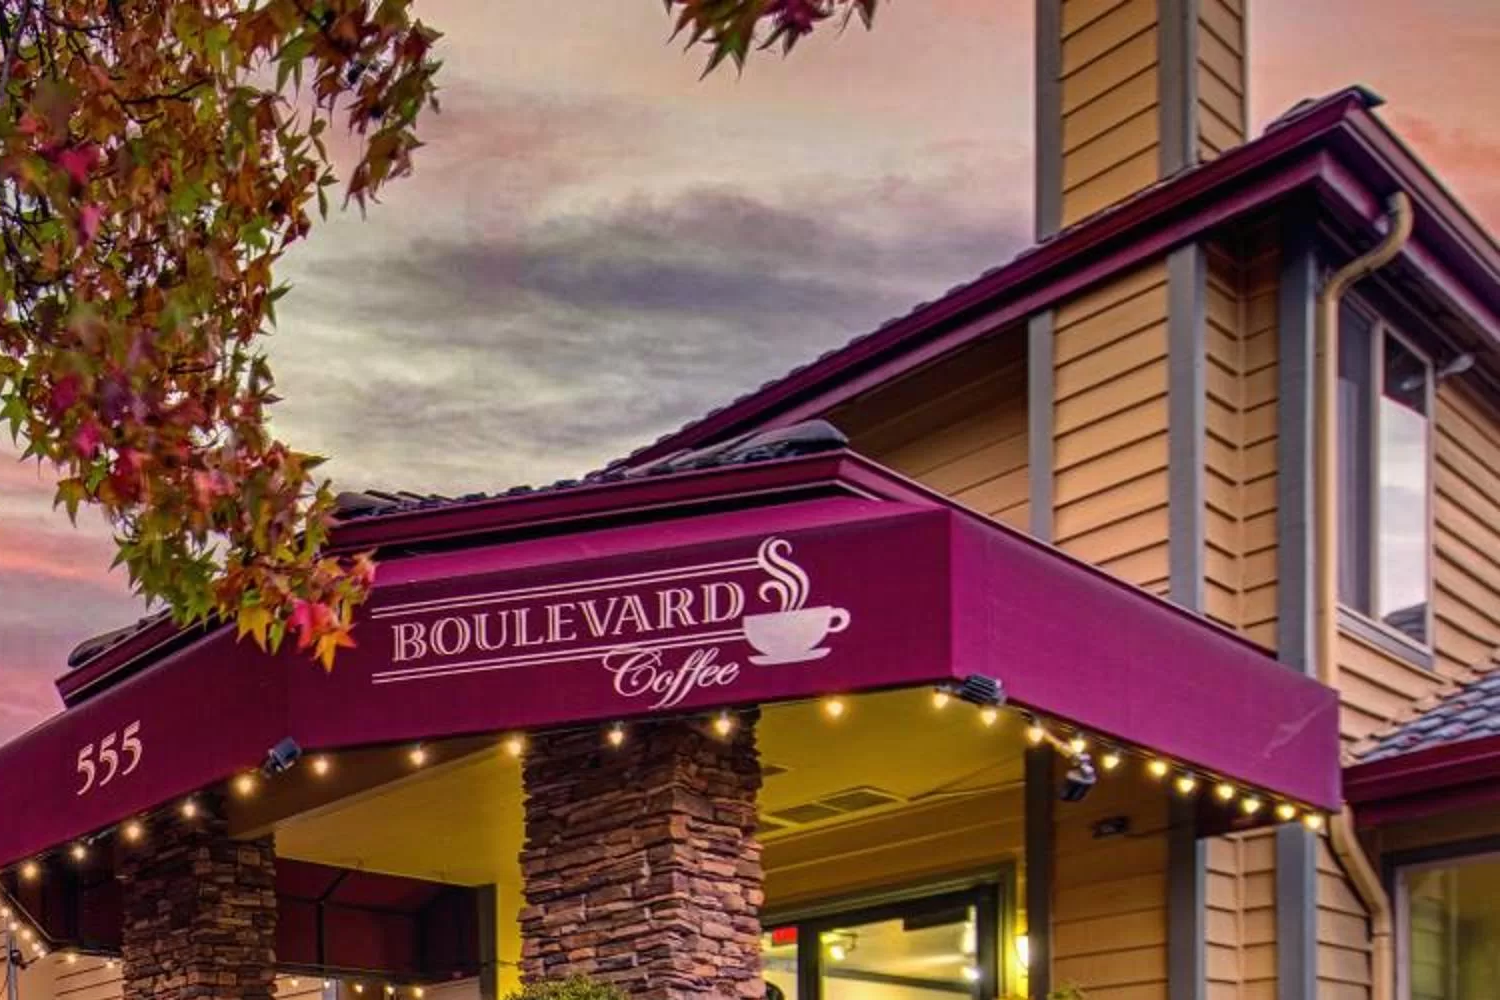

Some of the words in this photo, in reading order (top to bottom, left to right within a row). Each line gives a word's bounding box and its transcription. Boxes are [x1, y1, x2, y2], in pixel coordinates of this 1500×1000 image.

[391, 582, 745, 662] BOULEVARD
[602, 647, 740, 710] Coffee
[76, 719, 143, 796] 555
